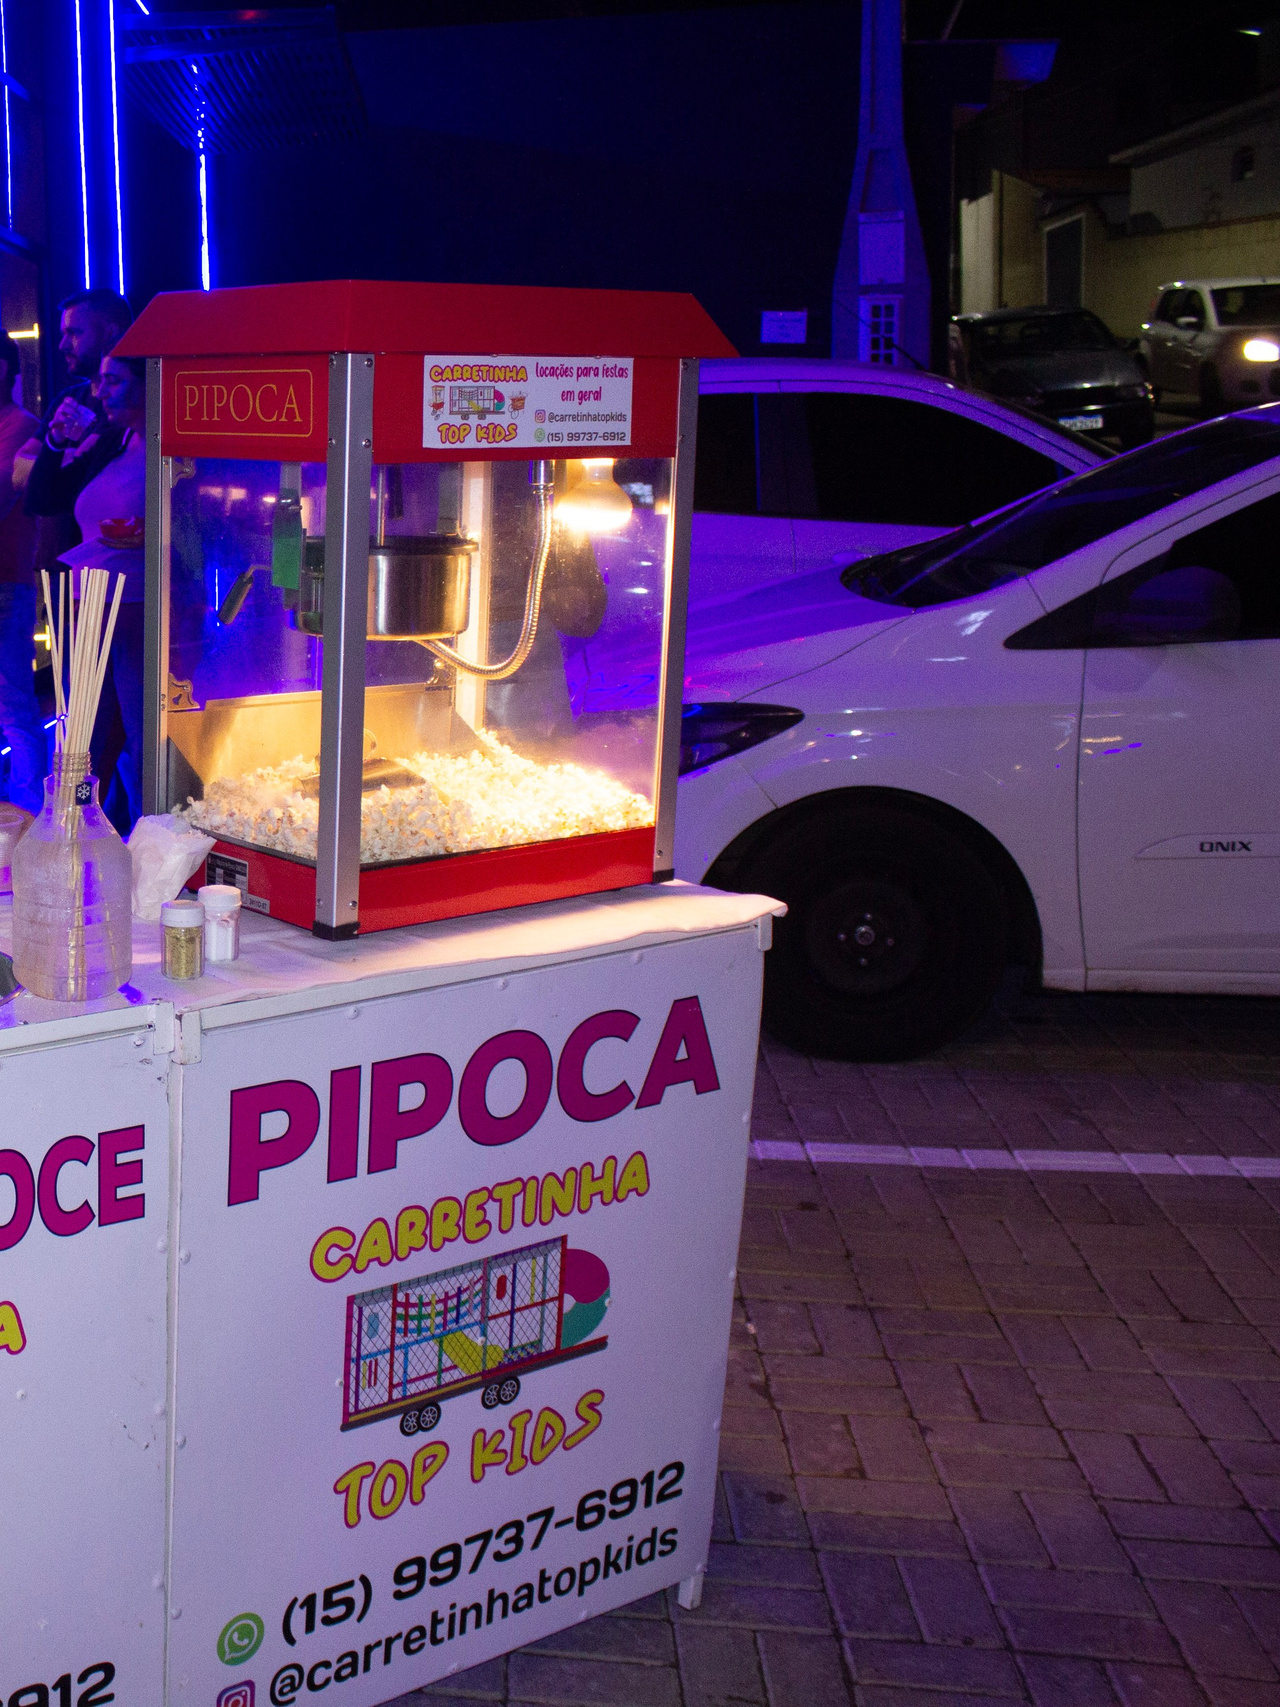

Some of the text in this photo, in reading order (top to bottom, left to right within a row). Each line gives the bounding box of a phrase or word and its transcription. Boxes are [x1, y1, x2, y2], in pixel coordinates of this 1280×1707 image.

[430, 364, 528, 383] CARRETINHA
[535, 362, 629, 381] locações para festas
[184, 383, 303, 422] PIPOCA
[561, 386, 602, 405] em geral
[548, 410, 627, 423] @carretinhatopkids
[438, 423, 518, 444] TOP KIDS
[547, 432, 626, 443] (15) 99737-6912
[1200, 841, 1252, 852] ONIX
[228, 995, 721, 1206] PIPOCA
[310, 1151, 650, 1283] CARRETINHA
[333, 1389, 605, 1528] TOP KIDS
[282, 1461, 685, 1646] (15) 99737-6912
[269, 1526, 679, 1706] @carretinhatopkids
